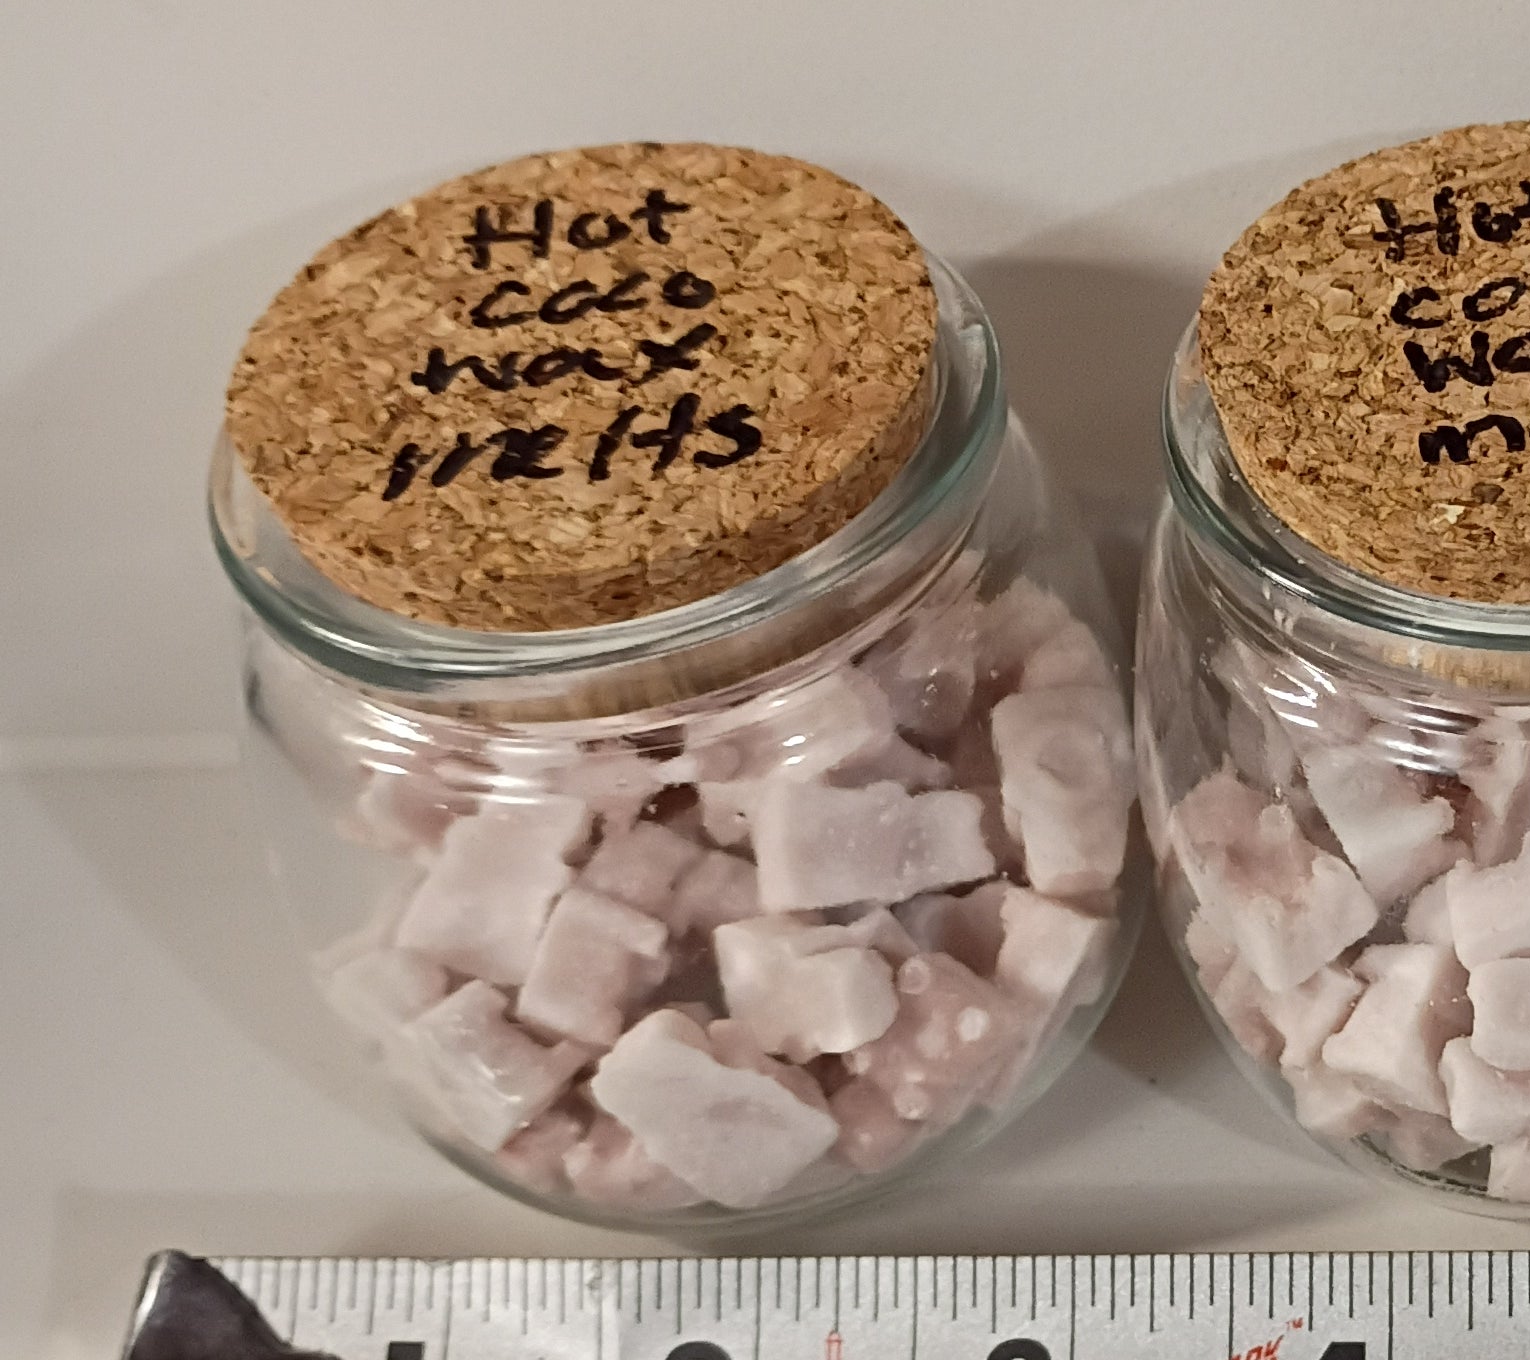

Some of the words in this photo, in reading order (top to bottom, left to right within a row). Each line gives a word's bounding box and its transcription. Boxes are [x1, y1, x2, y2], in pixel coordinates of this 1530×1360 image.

[462, 189, 690, 269] Hot
[472, 271, 718, 329] coco
[411, 322, 728, 394] wax
